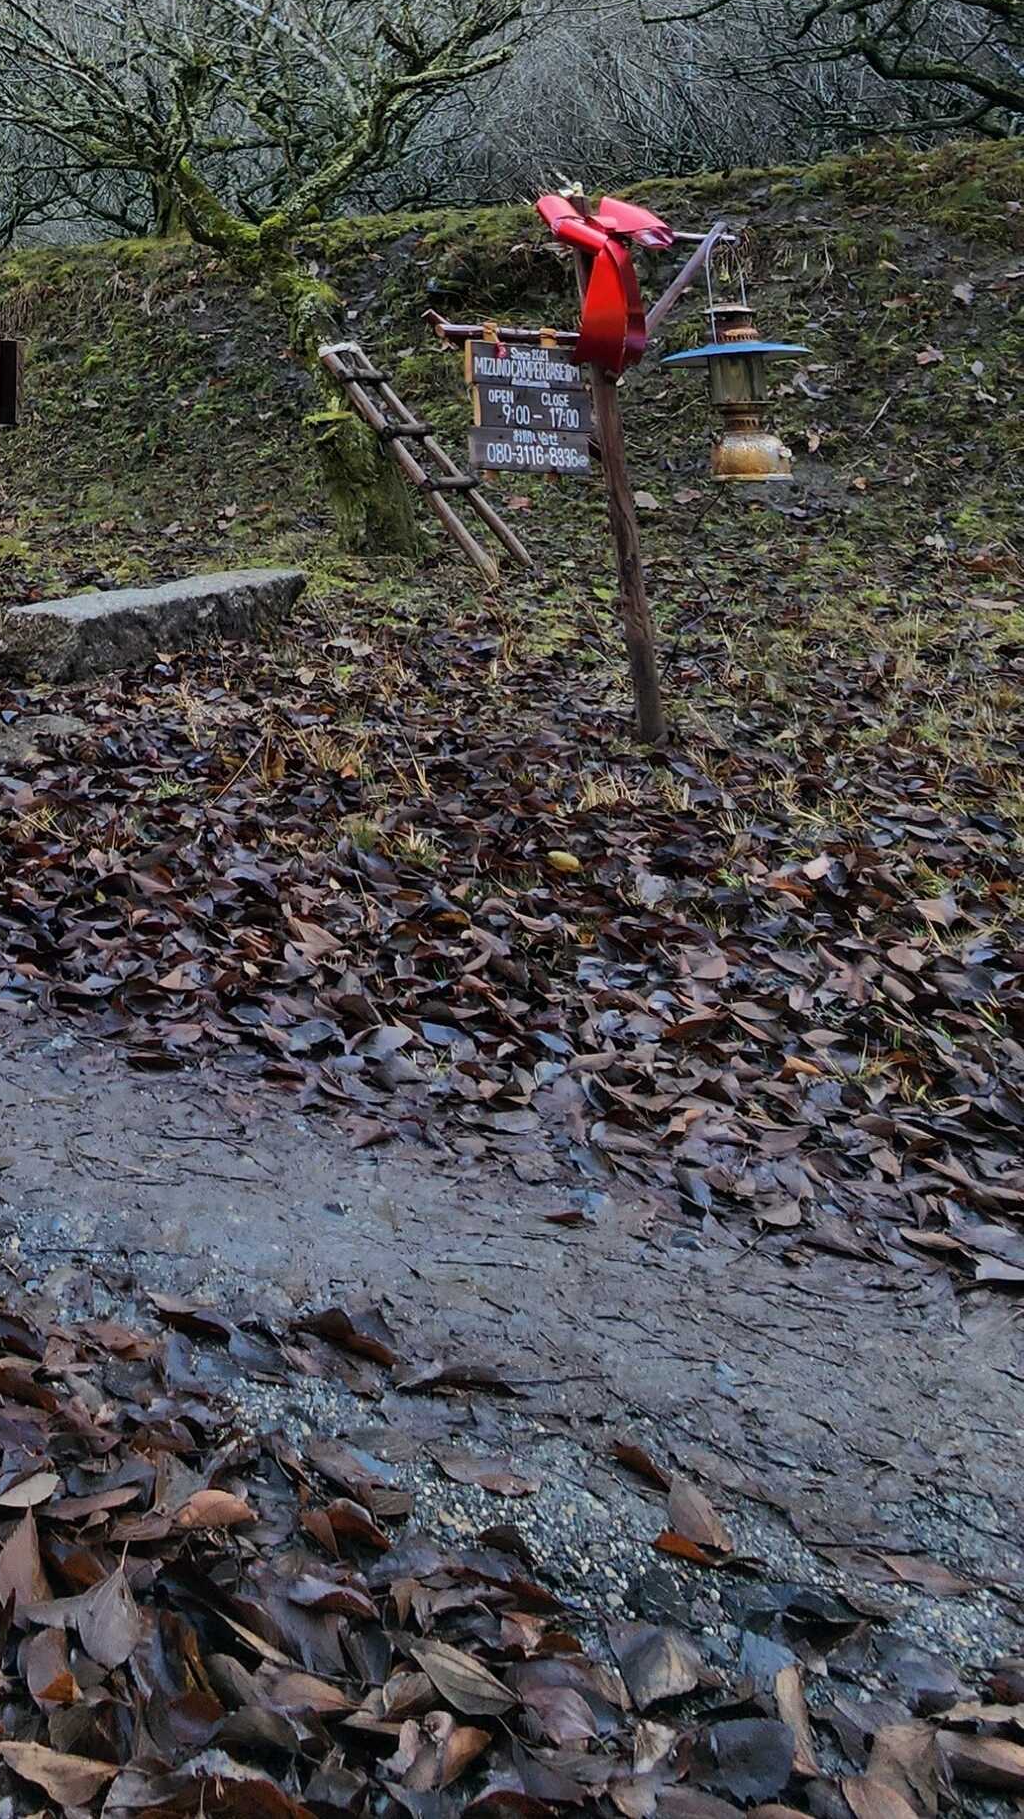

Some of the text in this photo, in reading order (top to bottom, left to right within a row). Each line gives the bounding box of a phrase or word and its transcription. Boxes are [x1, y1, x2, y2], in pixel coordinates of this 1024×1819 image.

[474, 356, 511, 377] MIZUNO
[511, 359, 546, 381] CAMPER
[488, 389, 570, 407] OPEN CLOSE
[502, 404, 531, 425] 9:00
[549, 407, 580, 429] 17:00
[486, 443, 578, 468] 080-3116-8336
